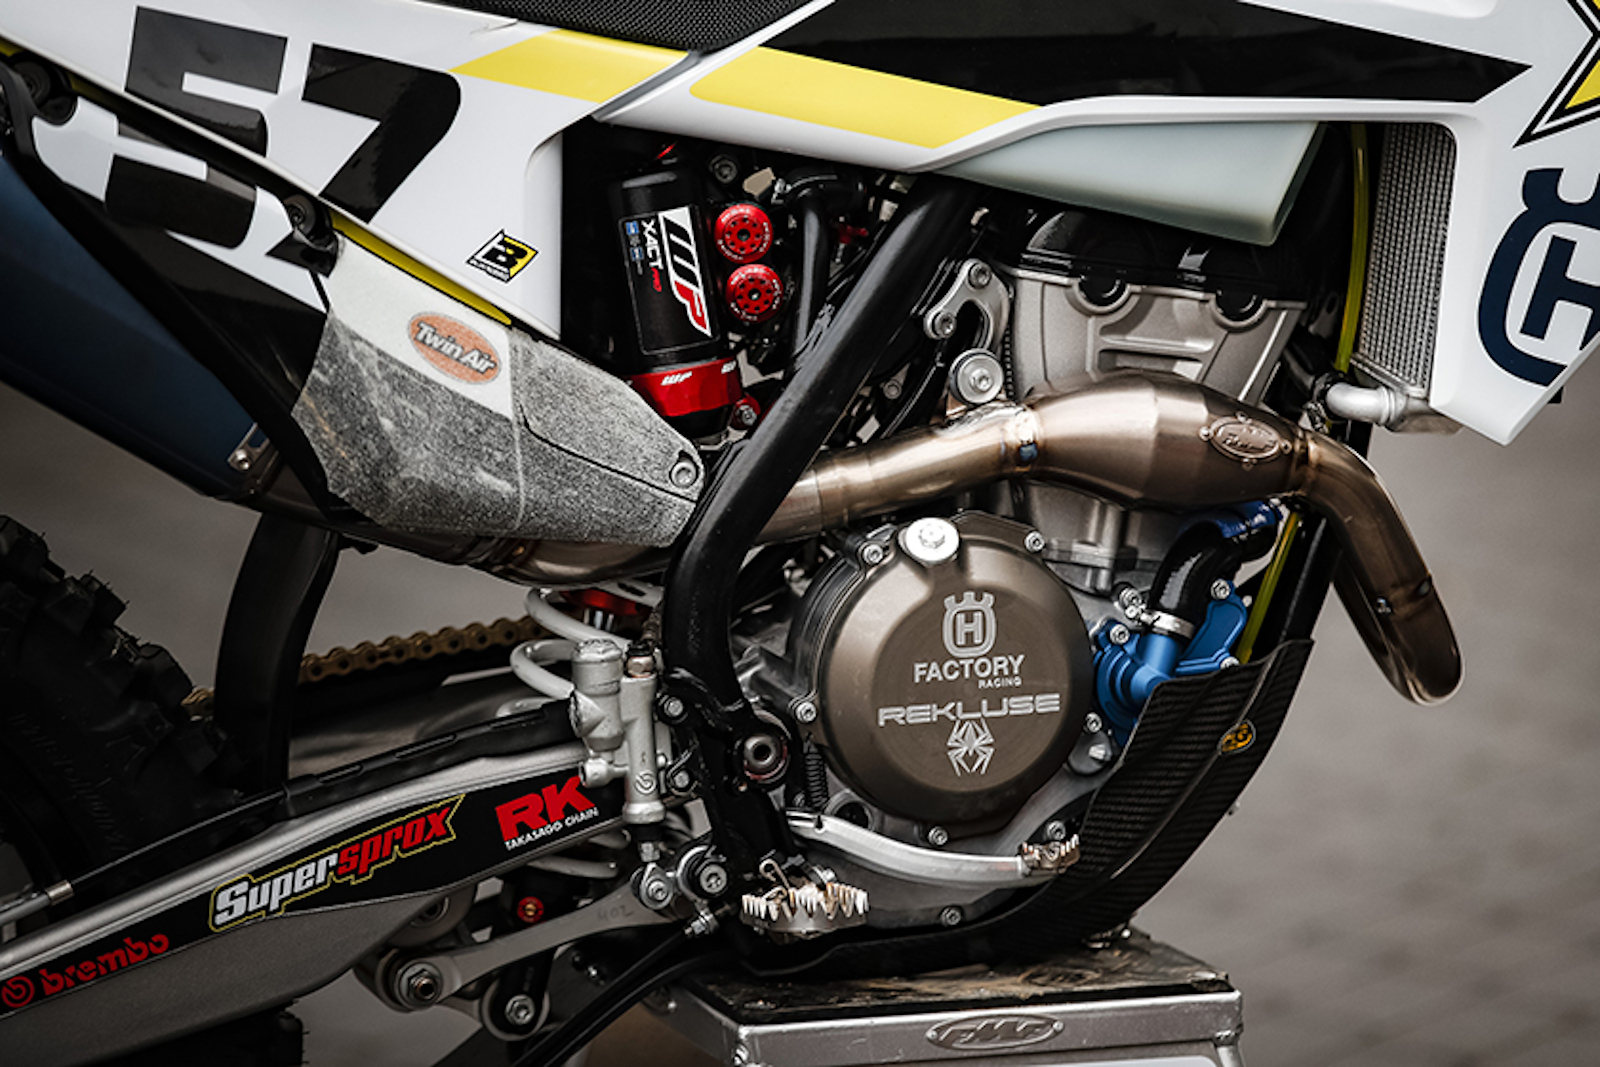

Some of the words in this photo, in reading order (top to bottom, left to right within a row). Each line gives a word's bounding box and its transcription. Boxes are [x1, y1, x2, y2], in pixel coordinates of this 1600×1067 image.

[104, 6, 461, 250] 57
[413, 320, 464, 361] Twin
[460, 348, 497, 375] Air
[914, 654, 1026, 684] FACTORY
[978, 675, 1023, 690] RACING
[878, 692, 1061, 728] REKLUSE
[495, 774, 596, 842] RK
[504, 819, 563, 851] TAKASAGO
[564, 806, 600, 828] CHAIN
[214, 806, 451, 926] Supersprox
[38, 932, 170, 997] brembo
